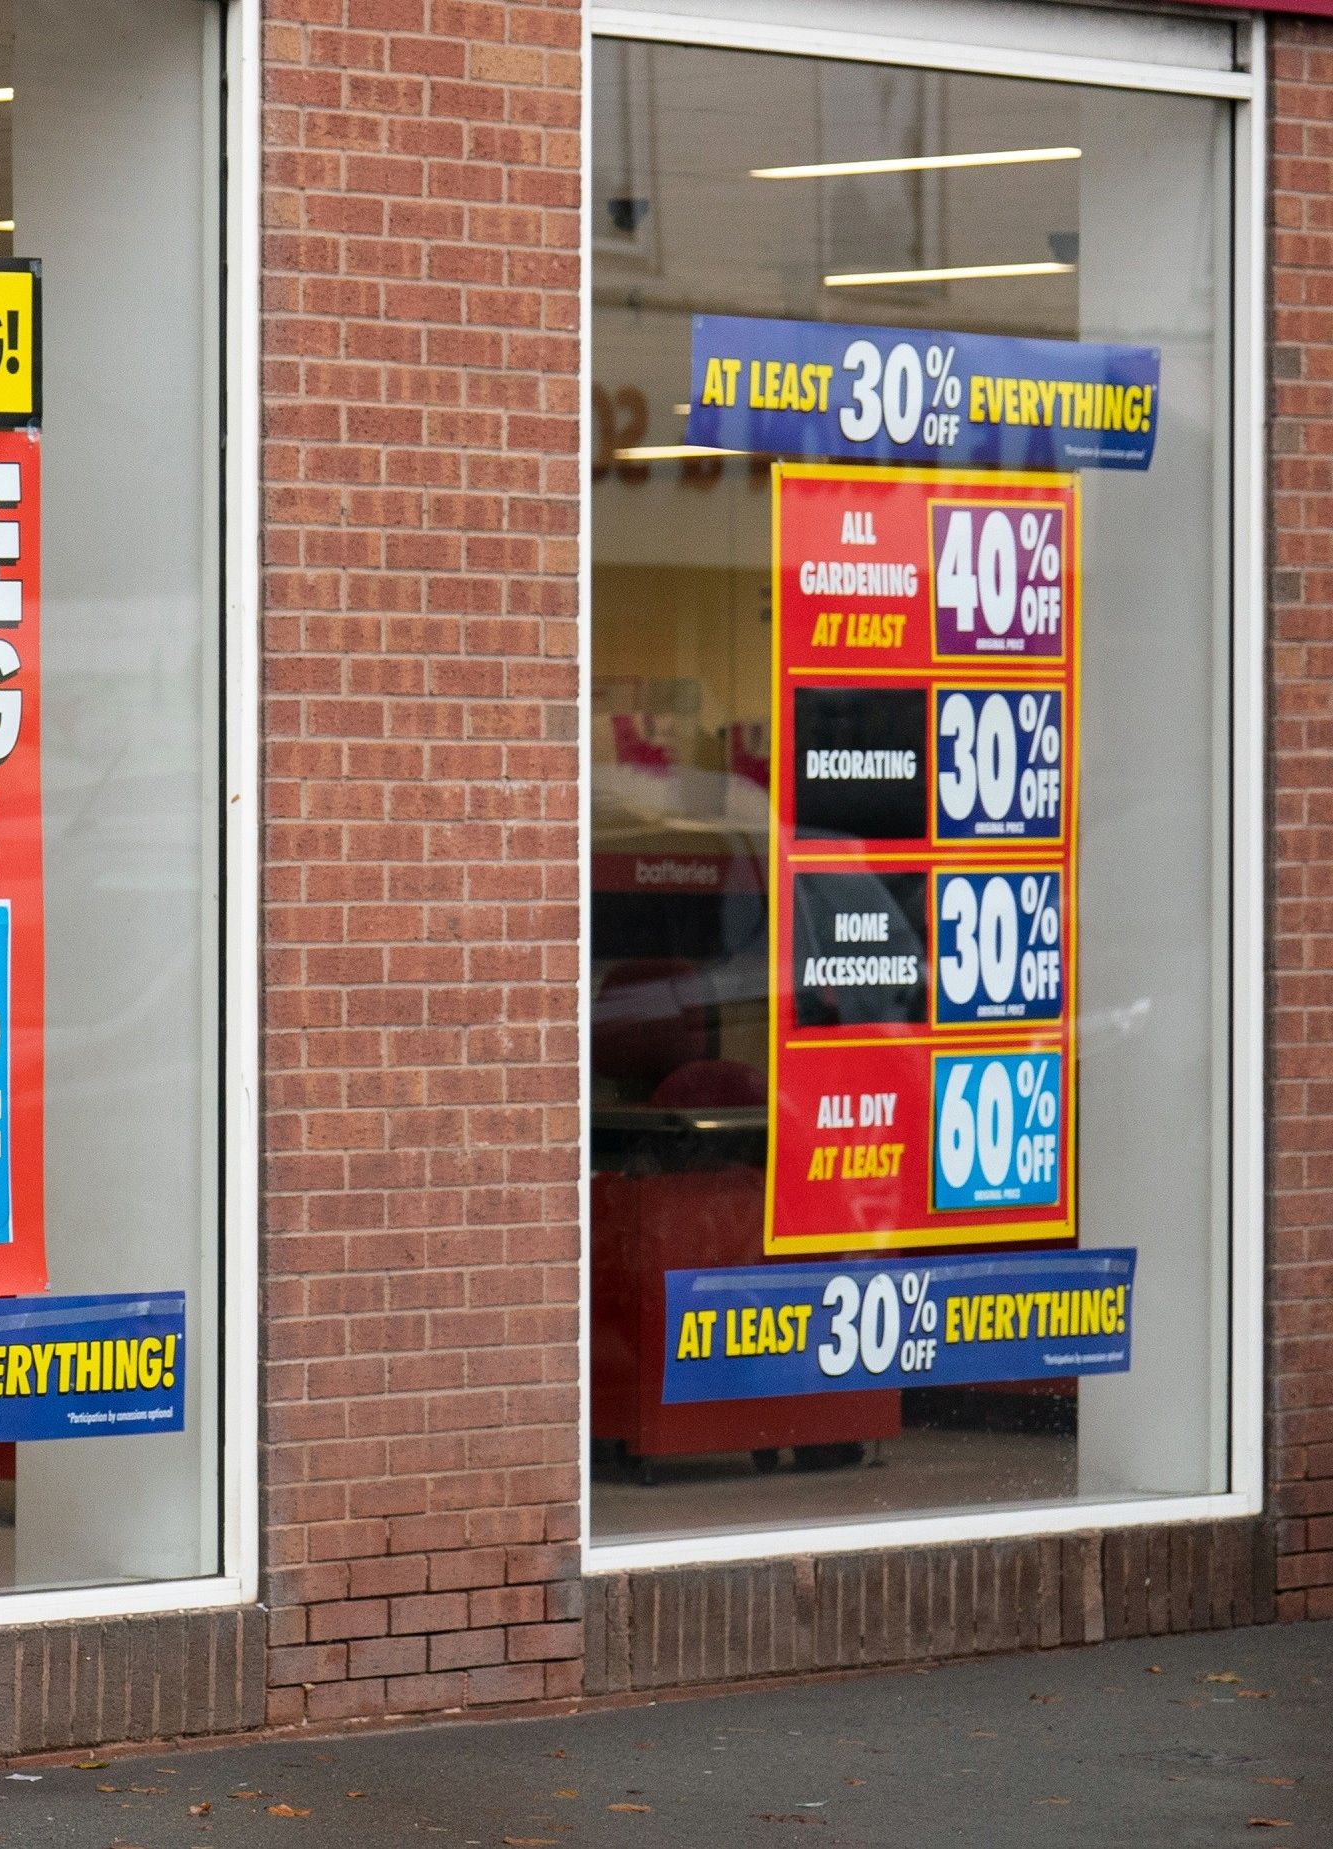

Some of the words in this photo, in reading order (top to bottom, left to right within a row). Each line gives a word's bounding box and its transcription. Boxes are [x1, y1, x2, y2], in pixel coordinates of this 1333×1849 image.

[702, 358, 738, 407] AT
[749, 362, 834, 413] LEAST
[923, 413, 960, 445] OFF
[840, 510, 877, 546] ALL
[800, 560, 918, 598] GARDENING
[936, 510, 1061, 635] 40%
[1020, 585, 1061, 635] OFF
[812, 613, 842, 646] AT
[846, 614, 906, 647] LEAST
[806, 750, 916, 779] DECORATING
[938, 694, 1060, 820] 30%
[1020, 769, 1060, 819] OFF
[835, 913, 888, 942] HOME
[940, 877, 1060, 1004] 30%
[1020, 951, 1060, 1000] OFF
[803, 955, 918, 987] ACCESSORIES
[817, 1095, 854, 1129] ALL
[859, 1093, 896, 1127] DIY
[940, 1062, 1055, 1187] 60%
[1017, 1135, 1055, 1183] OFF
[808, 1146, 838, 1180] AT
[842, 1144, 904, 1179] LEAST
[676, 1310, 717, 1360] AT
[726, 1305, 813, 1357] LEAST
[901, 1339, 936, 1371] OFF
